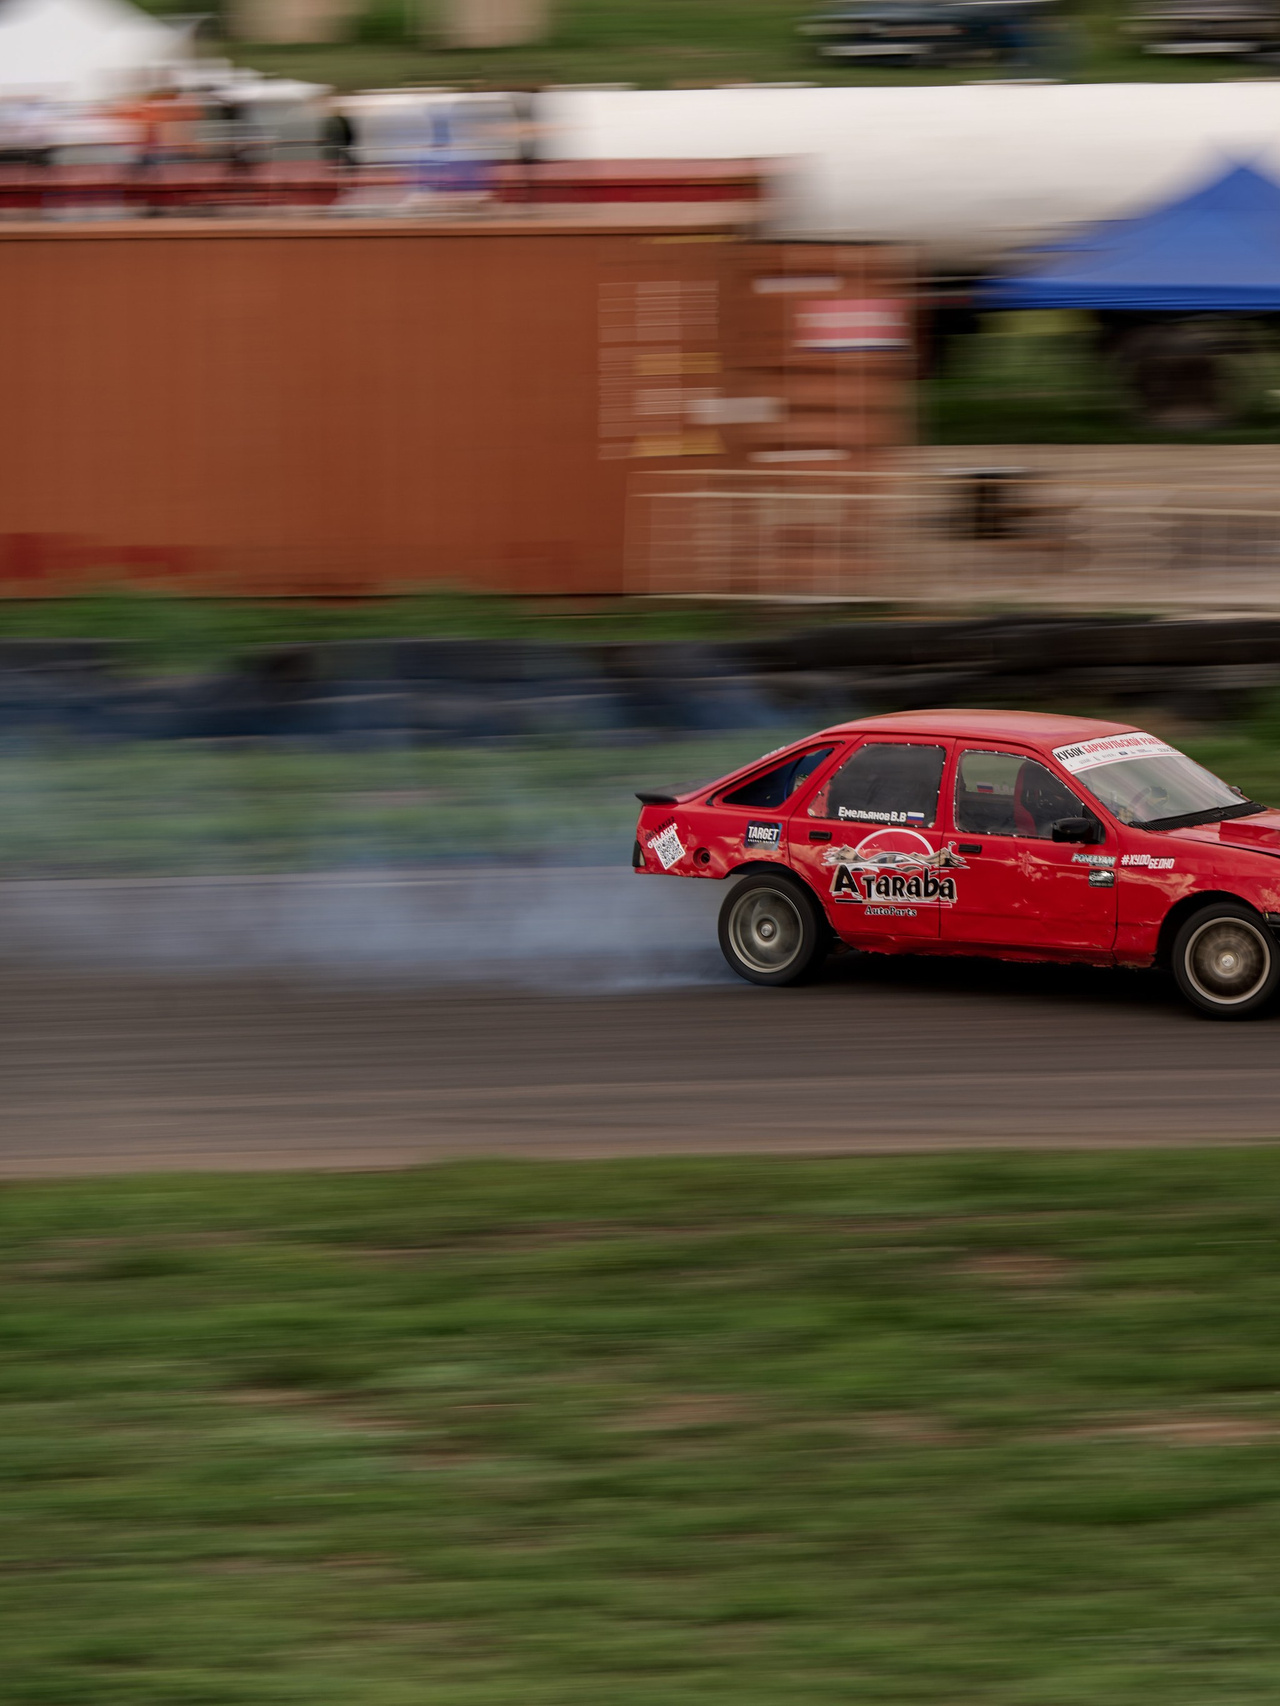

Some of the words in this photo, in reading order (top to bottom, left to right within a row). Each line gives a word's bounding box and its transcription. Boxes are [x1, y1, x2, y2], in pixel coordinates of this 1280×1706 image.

[1055, 746, 1086, 762] КУБОК
[838, 806, 891, 821] Емельянов
[748, 826, 780, 840] TARGET
[865, 906, 917, 916] AutoParts
